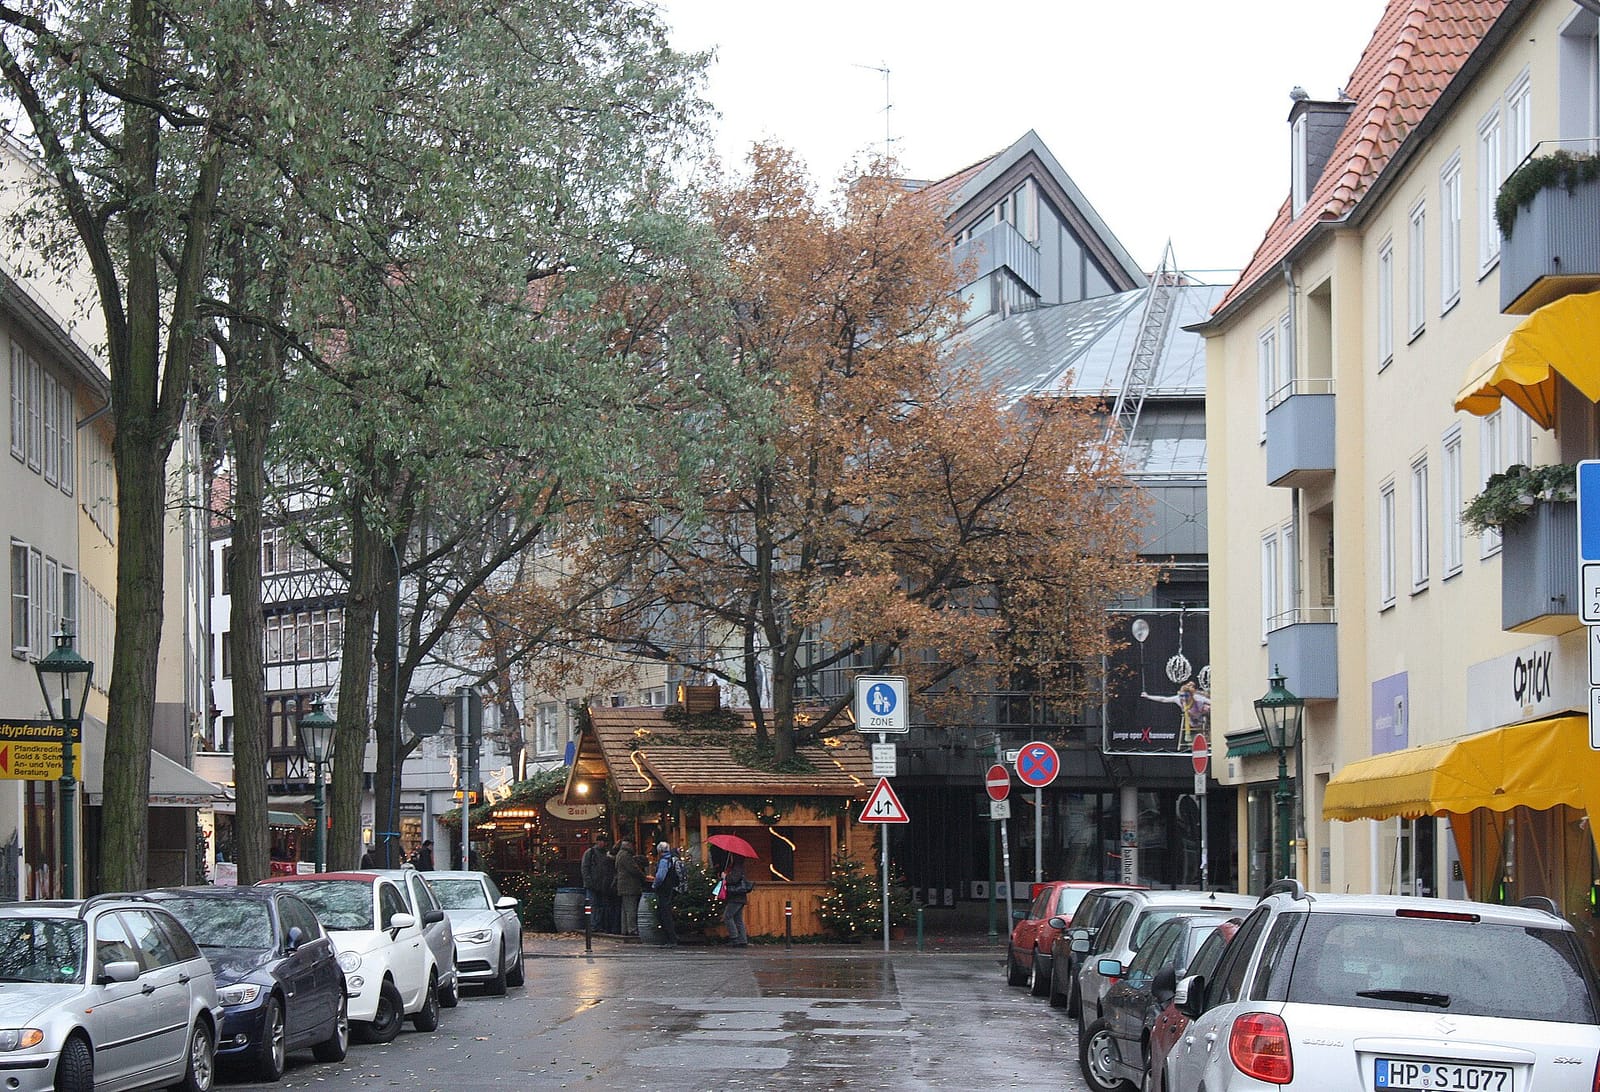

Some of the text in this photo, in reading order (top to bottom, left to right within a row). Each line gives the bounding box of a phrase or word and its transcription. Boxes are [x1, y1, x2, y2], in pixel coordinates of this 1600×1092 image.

[870, 717, 894, 726] ZONE
[0, 724, 79, 738] itypfandhas
[14, 752, 32, 760] Gold
[14, 768, 49, 777] Beratung
[1390, 1064, 1419, 1085] HP
